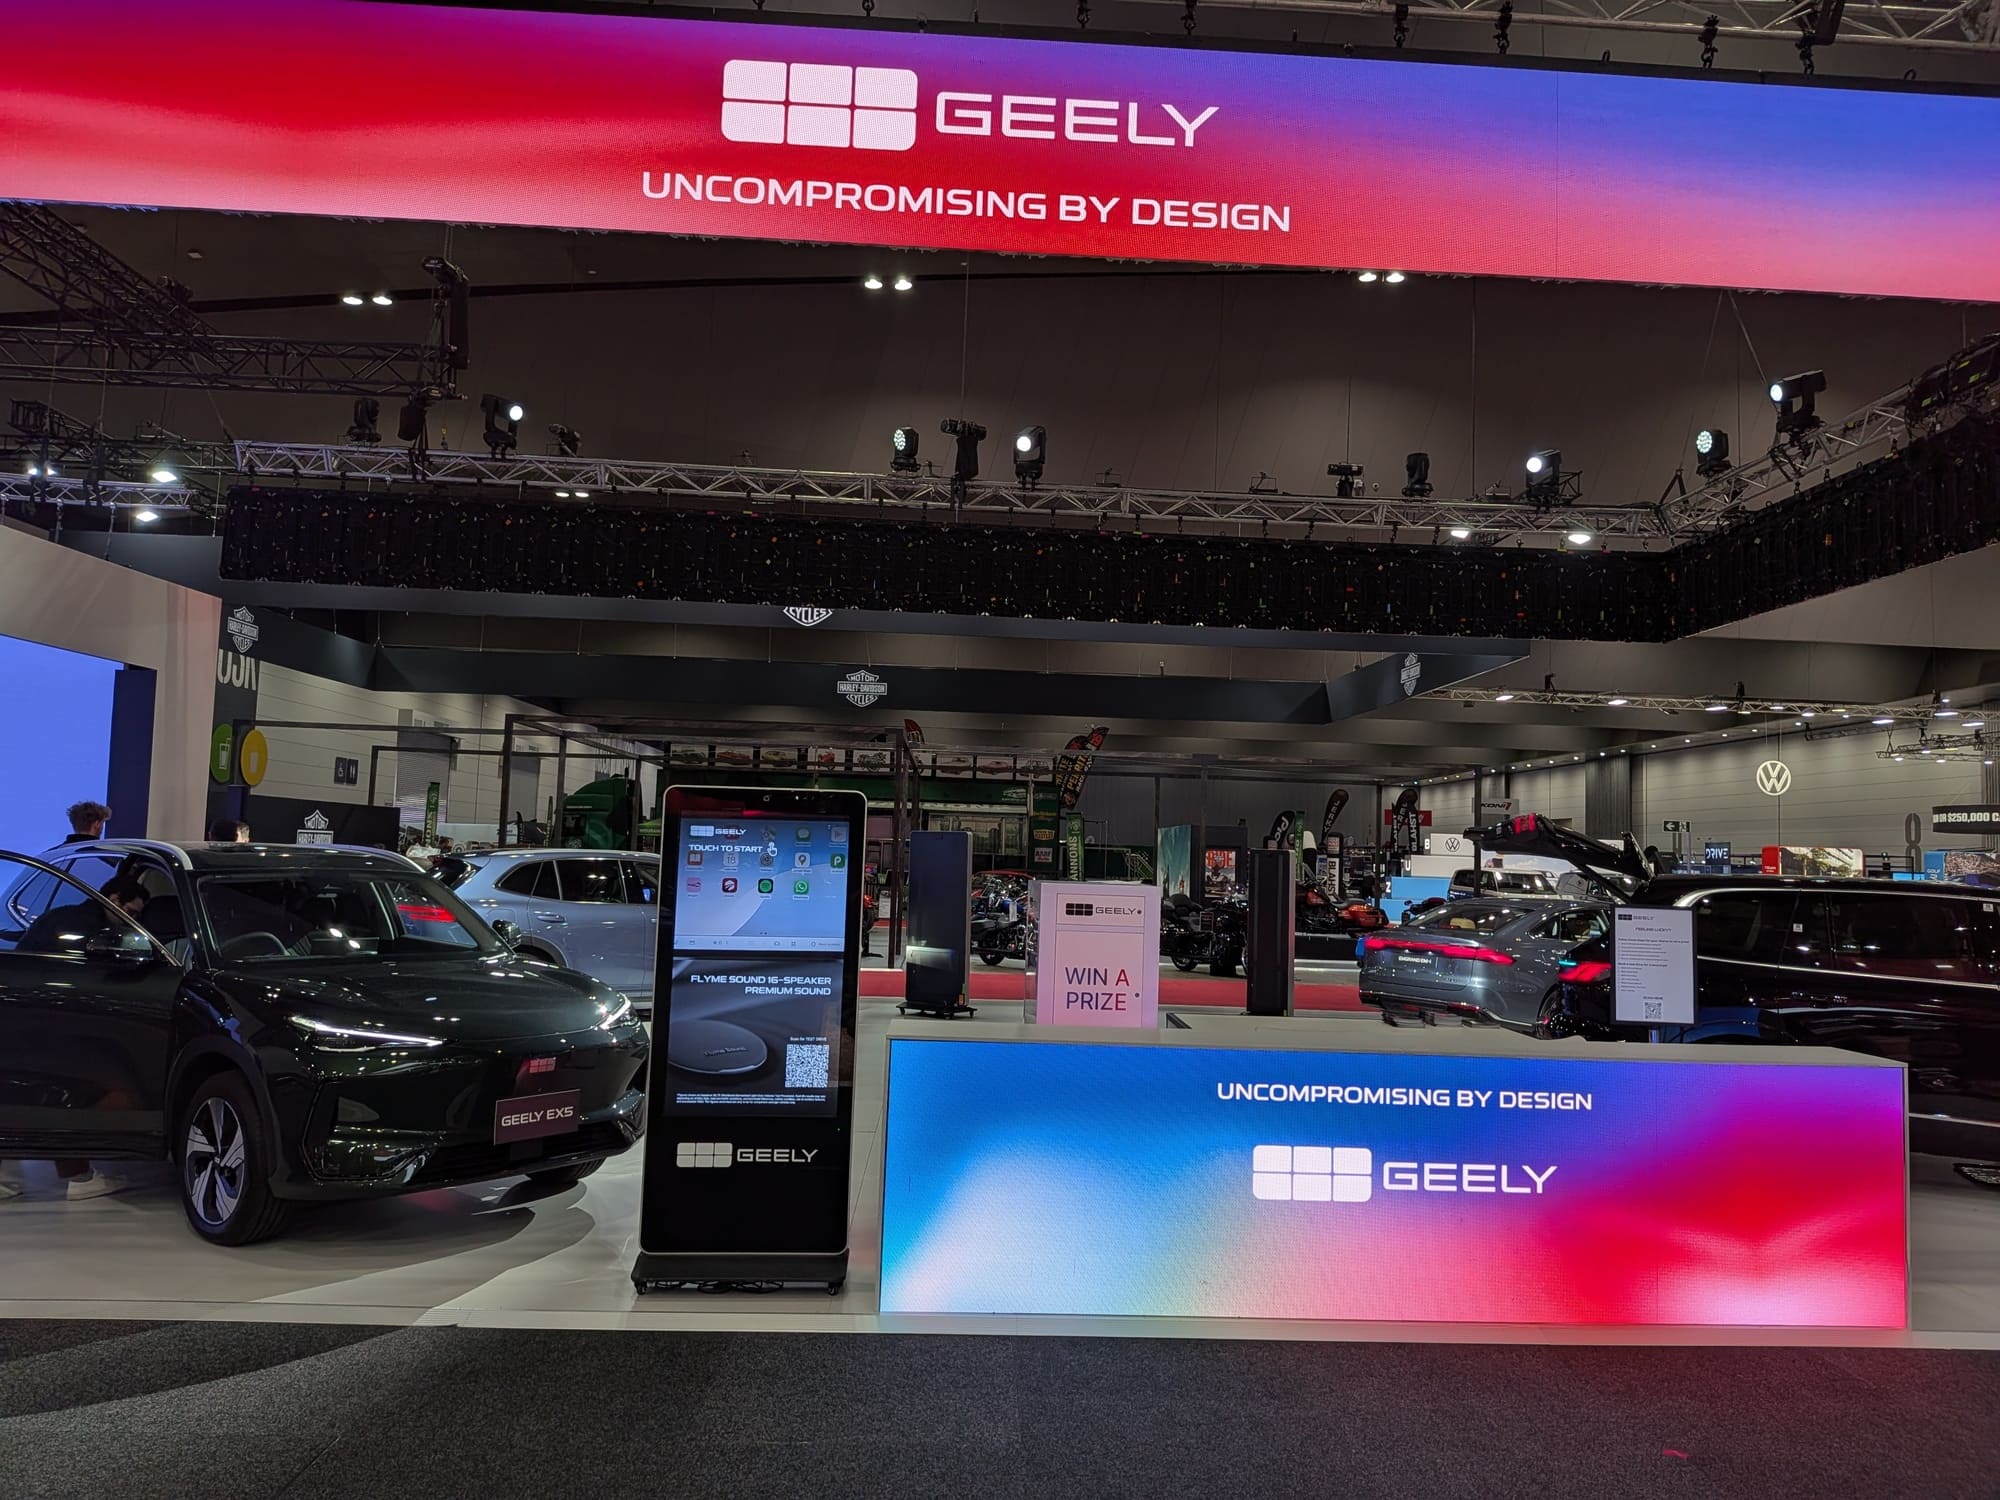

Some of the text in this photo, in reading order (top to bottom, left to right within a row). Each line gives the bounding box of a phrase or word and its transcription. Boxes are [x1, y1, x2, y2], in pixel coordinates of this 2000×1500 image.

[935, 91, 1219, 148] GEELY
[641, 171, 1291, 232] UNCOMPROMISING BY DESIGN
[789, 607, 827, 623] CYCLES
[839, 683, 885, 693] HARLEY-DAVIDSON
[1947, 812, 1990, 823] $250,000
[1991, 812, 2000, 823] C
[715, 828, 747, 836] GEELY
[688, 844, 763, 853] TOUCH TO START
[1705, 847, 1728, 859] DRIVE
[1095, 906, 1136, 915] GEELY
[690, 975, 832, 985] FLYME SOUND 16-SPEAKER
[1065, 967, 1130, 986] WIN A
[744, 986, 831, 995] PREMIUM SOUND
[1066, 991, 1127, 1011] PRIZE
[1217, 1082, 1592, 1110] UNCOMPROMISING BY DESIGN
[501, 1106, 574, 1127] GEELY EX5
[736, 1149, 818, 1163] GEELY
[1383, 1161, 1558, 1195] GEELY
